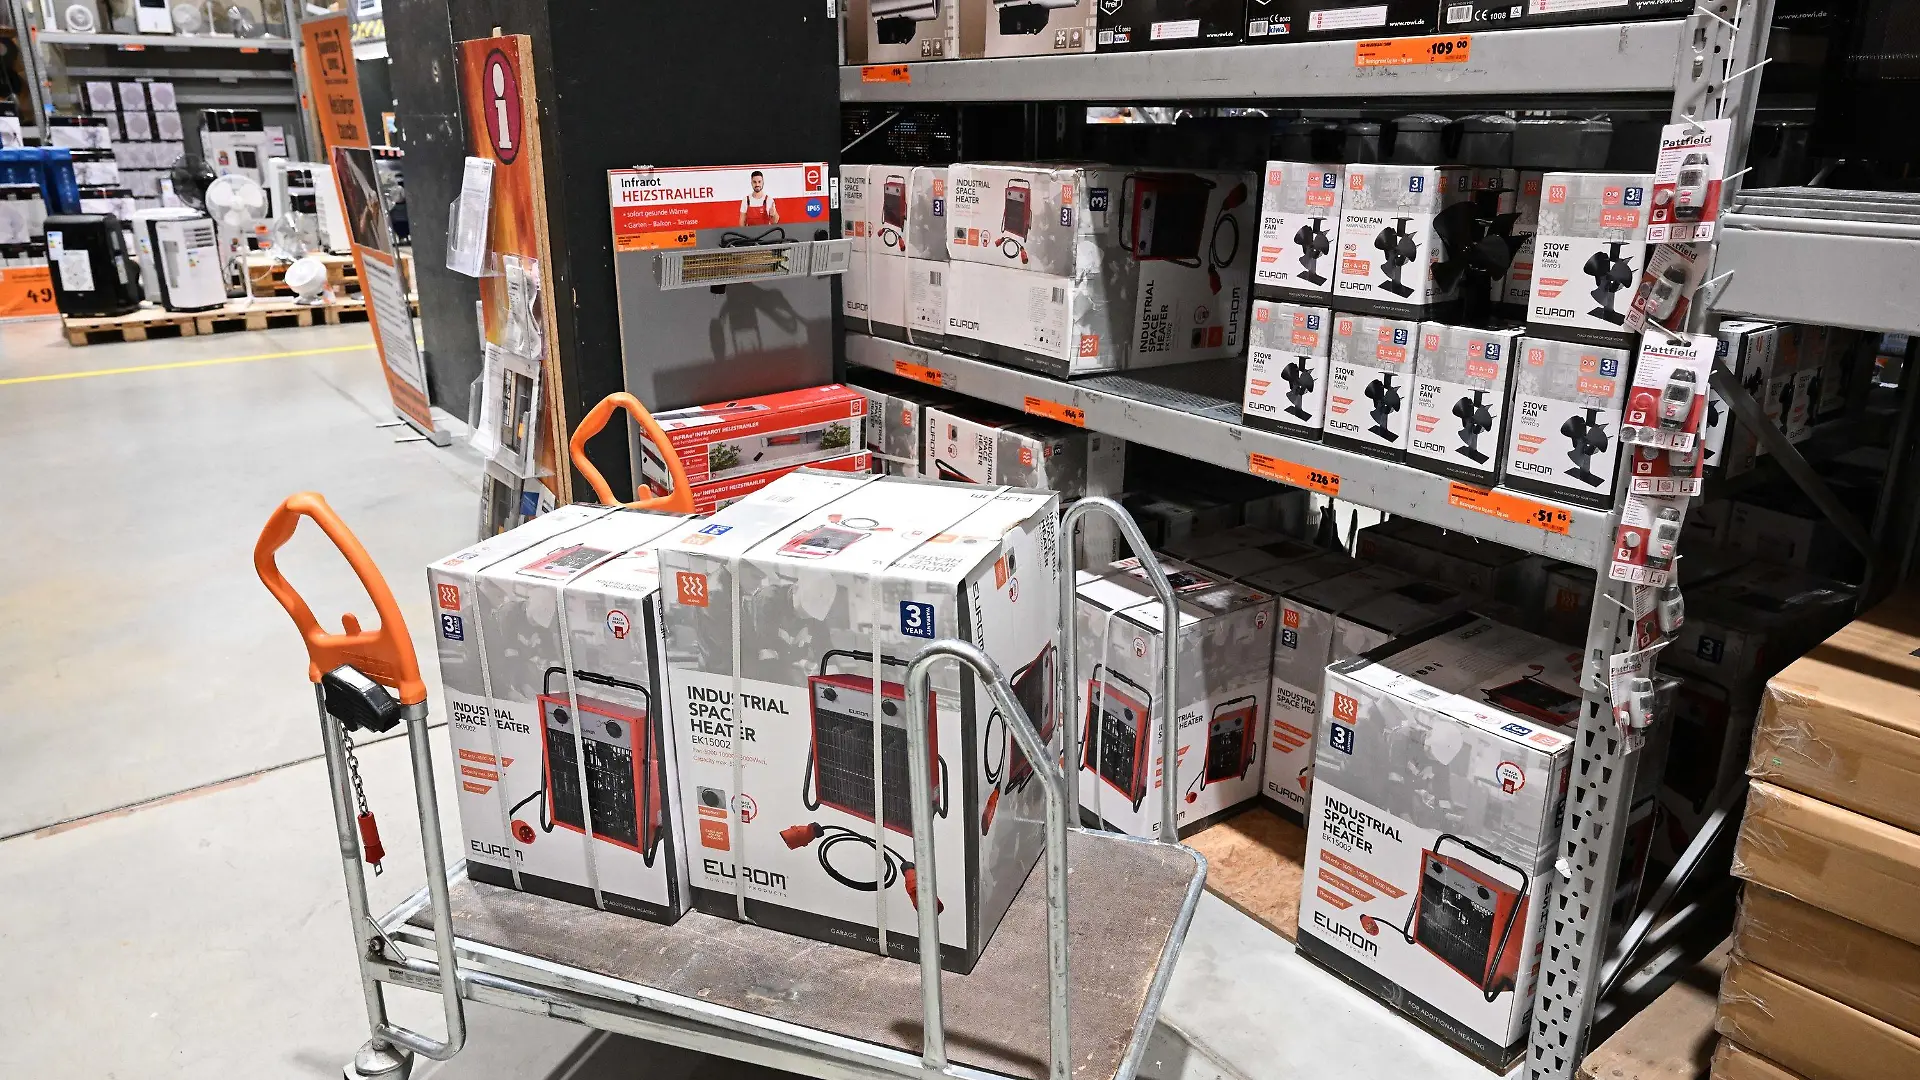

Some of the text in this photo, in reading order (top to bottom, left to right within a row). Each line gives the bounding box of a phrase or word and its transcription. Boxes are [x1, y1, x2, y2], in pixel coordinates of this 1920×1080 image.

[1474, 9, 1507, 21] CE 1008
[1777, 11, 1828, 20] www.rowi.de
[1269, 25, 1285, 33] kiwa
[1389, 18, 1425, 28] www.rowi.de
[1662, 135, 1712, 148] Pattfield
[620, 176, 662, 188] Infrarot
[844, 177, 872, 186] INDUSTRIL
[956, 178, 991, 189] INDUSTRIAL
[1324, 173, 1332, 183] 3
[1411, 176, 1419, 187] 3
[844, 184, 859, 192] SPACE
[955, 187, 976, 196] SPACE
[622, 187, 714, 202] HEIZSTRAHLER
[844, 191, 863, 200] HEATER
[955, 195, 980, 205] HEATER
[1626, 188, 1636, 201] 3
[806, 203, 821, 212] IP65
[934, 200, 941, 212] 3
[626, 209, 644, 218] sofort
[644, 208, 668, 218] gesunde
[1061, 208, 1068, 223] 3
[627, 220, 648, 229] Garten
[677, 217, 699, 226] Terrasse
[1264, 217, 1284, 226] STOVE
[1346, 216, 1383, 225] STOVE FAN
[1543, 242, 1570, 251] STOVE
[1258, 270, 1288, 280] EUROM
[1339, 281, 1372, 292] EUROM
[1139, 279, 1155, 353] INDUSTRIAL
[1227, 286, 1241, 346] EUROM
[1535, 306, 1575, 318] EUROM
[949, 317, 980, 331] EUROM
[1308, 315, 1315, 326] 3
[1149, 313, 1160, 353] SPACE
[1157, 304, 1169, 352] HEATER
[1395, 329, 1403, 340] 3
[1486, 343, 1494, 355] 3
[1643, 343, 1698, 358] Pattfield
[1253, 357, 1265, 365] FAN
[1254, 351, 1272, 360] STOVE
[1601, 359, 1611, 371] 3
[1334, 373, 1347, 382] FAN
[1335, 366, 1354, 377] STOVE
[1419, 390, 1433, 399] FAN
[1420, 383, 1441, 394] STOVE
[1248, 401, 1276, 413] EUROM
[1522, 401, 1548, 412] STOVE
[1522, 408, 1538, 417] FAN
[695, 421, 760, 438] INFRAROT HEIZSTRAHLER
[1329, 419, 1359, 433] EUROM
[1413, 439, 1445, 454] EUROM
[1514, 460, 1553, 476] EUROM
[703, 486, 729, 495] INFRAROT
[729, 478, 766, 490] HEIZSTRAHLER
[905, 604, 922, 628] 3
[443, 615, 454, 633] 3
[905, 626, 924, 635] YEAR
[1283, 630, 1292, 642] 3
[687, 685, 790, 715] INDUTRIAL
[1276, 694, 1300, 709] SPACE
[848, 707, 869, 717] EUROM
[454, 712, 530, 735] SPACE EATER
[1179, 715, 1204, 730] HEATER
[1333, 726, 1346, 744] 3
[691, 735, 731, 750] EK15002
[1332, 741, 1345, 751] YEAR
[1268, 781, 1305, 806] EUROM
[1323, 808, 1365, 838] SPACE
[1324, 795, 1403, 843] INDUSTRIAL
[1321, 831, 1353, 854] EK15002
[1322, 820, 1374, 854] HEATER
[609, 900, 636, 912] ADDITIONAL
[830, 927, 857, 939] GARAGE
[1313, 910, 1379, 958] EUROM
[1407, 1000, 1486, 1051] FOR ADDITIONAL HEATING
